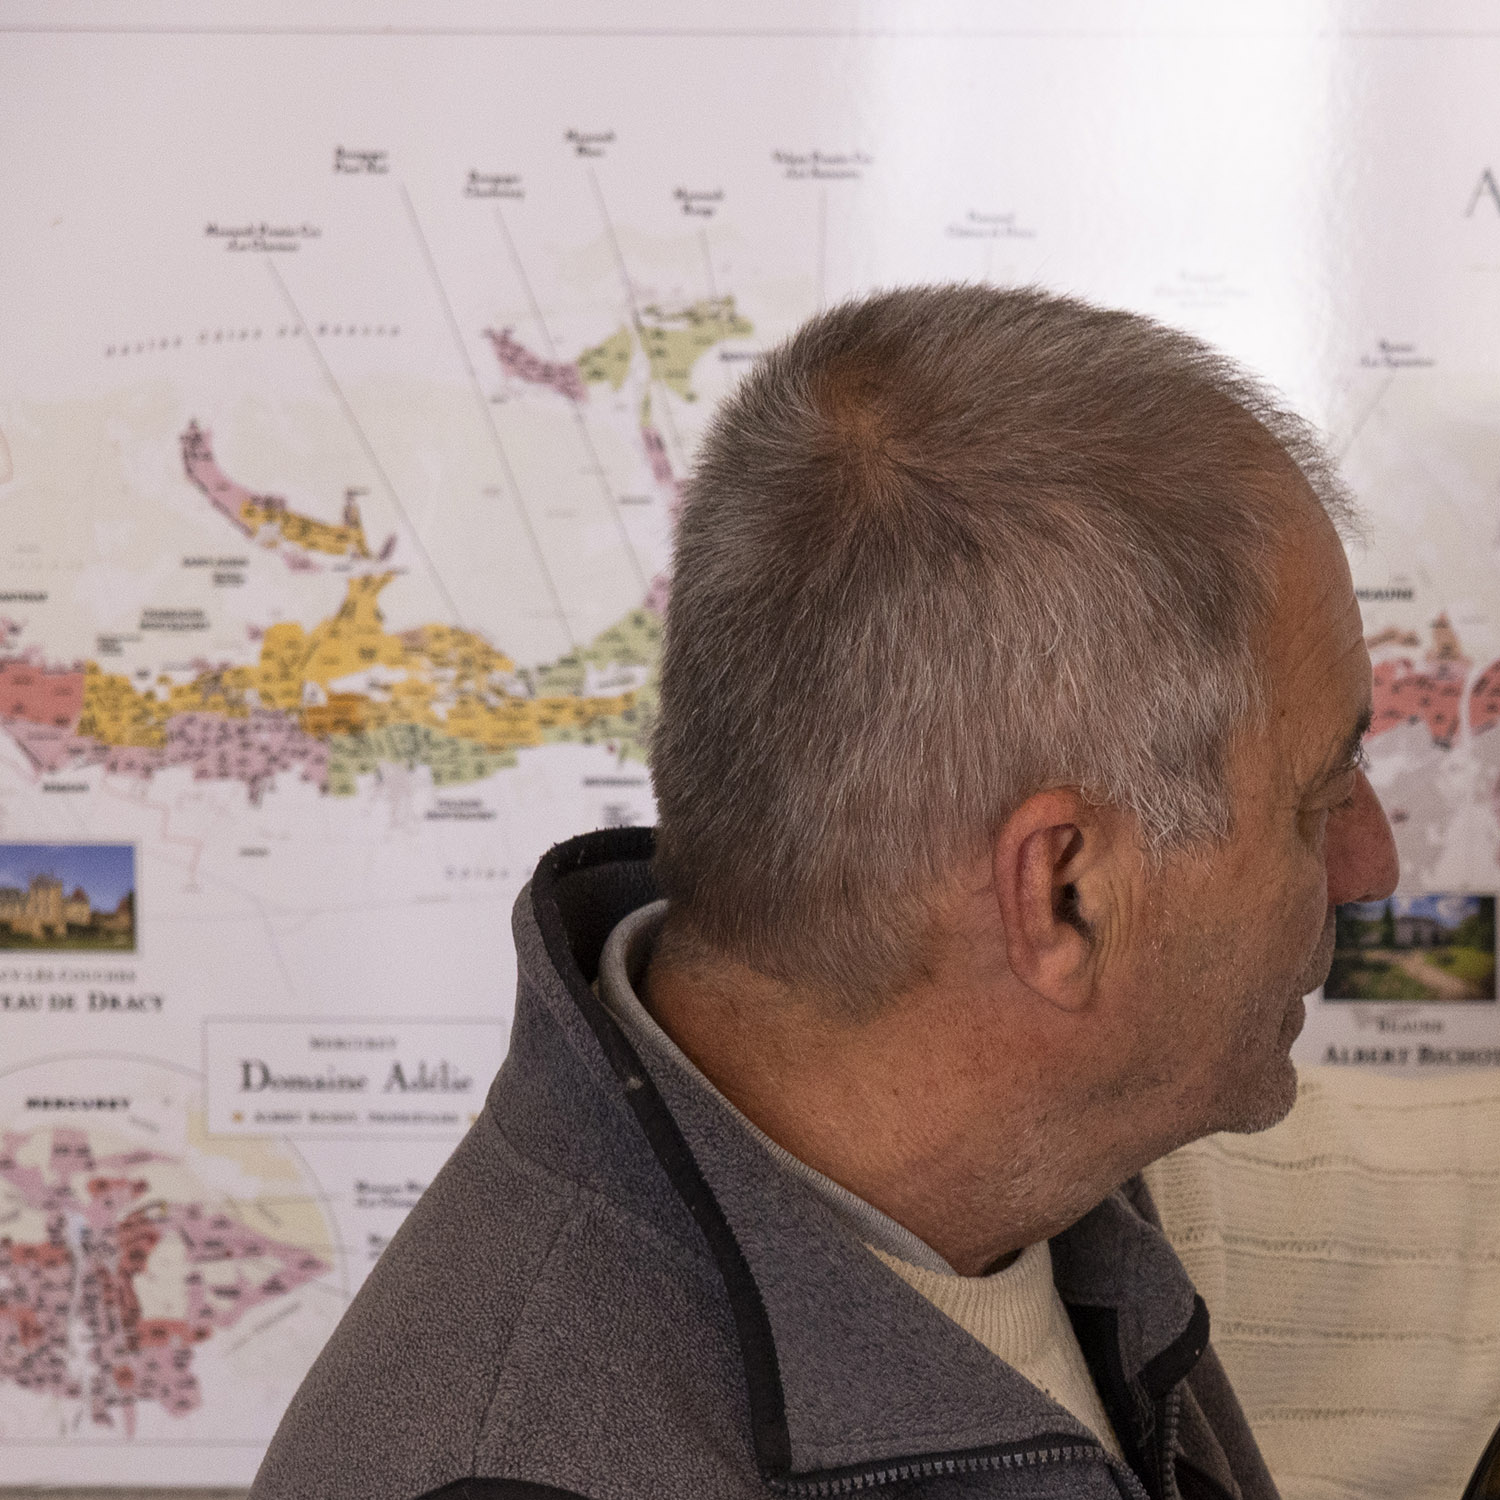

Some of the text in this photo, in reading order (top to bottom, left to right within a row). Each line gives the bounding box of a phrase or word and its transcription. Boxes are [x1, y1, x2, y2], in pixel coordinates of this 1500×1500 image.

[1324, 1044, 1409, 1065] ALBERT
[238, 1058, 475, 1094] Domaine Adélie
